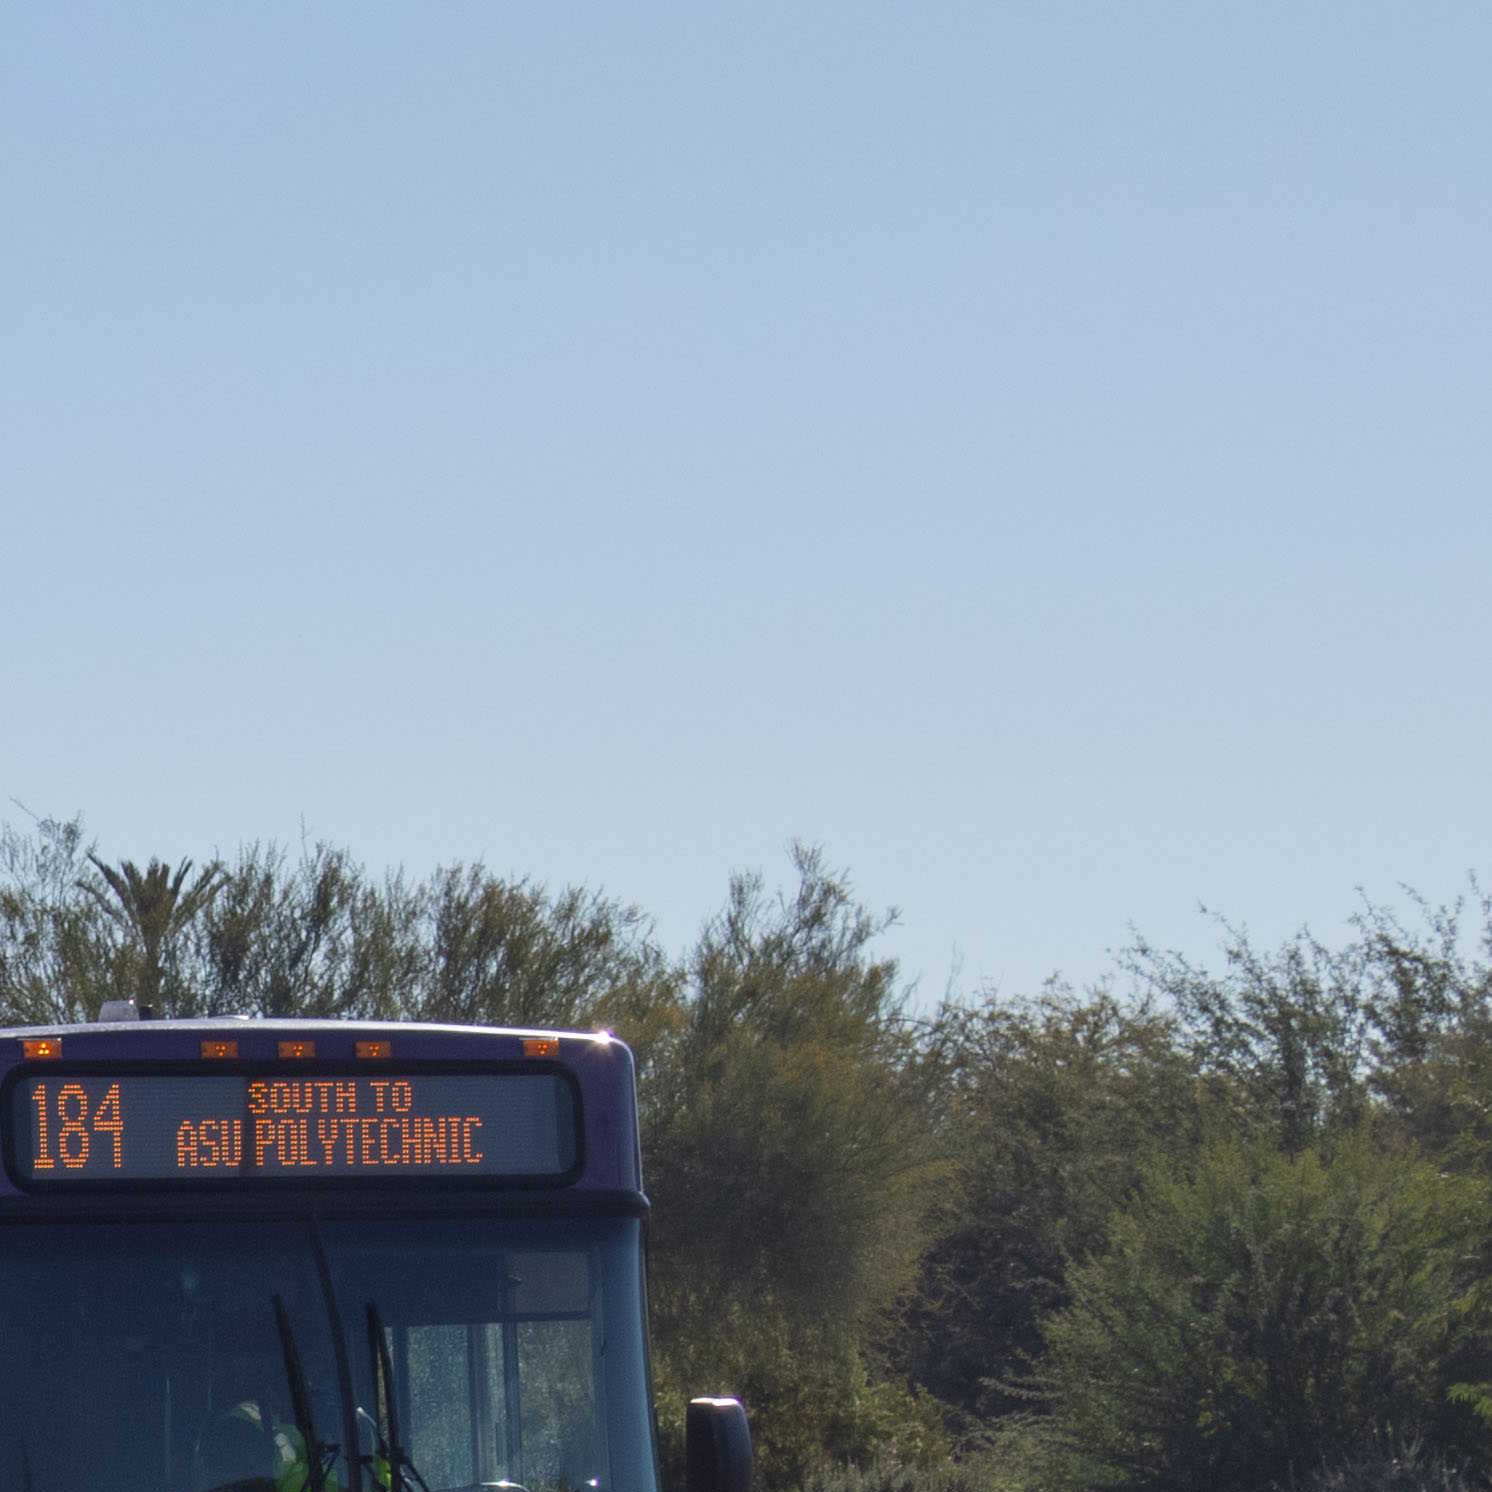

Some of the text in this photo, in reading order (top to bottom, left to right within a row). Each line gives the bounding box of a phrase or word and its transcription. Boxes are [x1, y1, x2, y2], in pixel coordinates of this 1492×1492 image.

[248, 1081, 412, 1114] SOUTH TO
[31, 1083, 123, 1169] 184
[177, 1116, 483, 1167] ASU POLYTECHNIC
